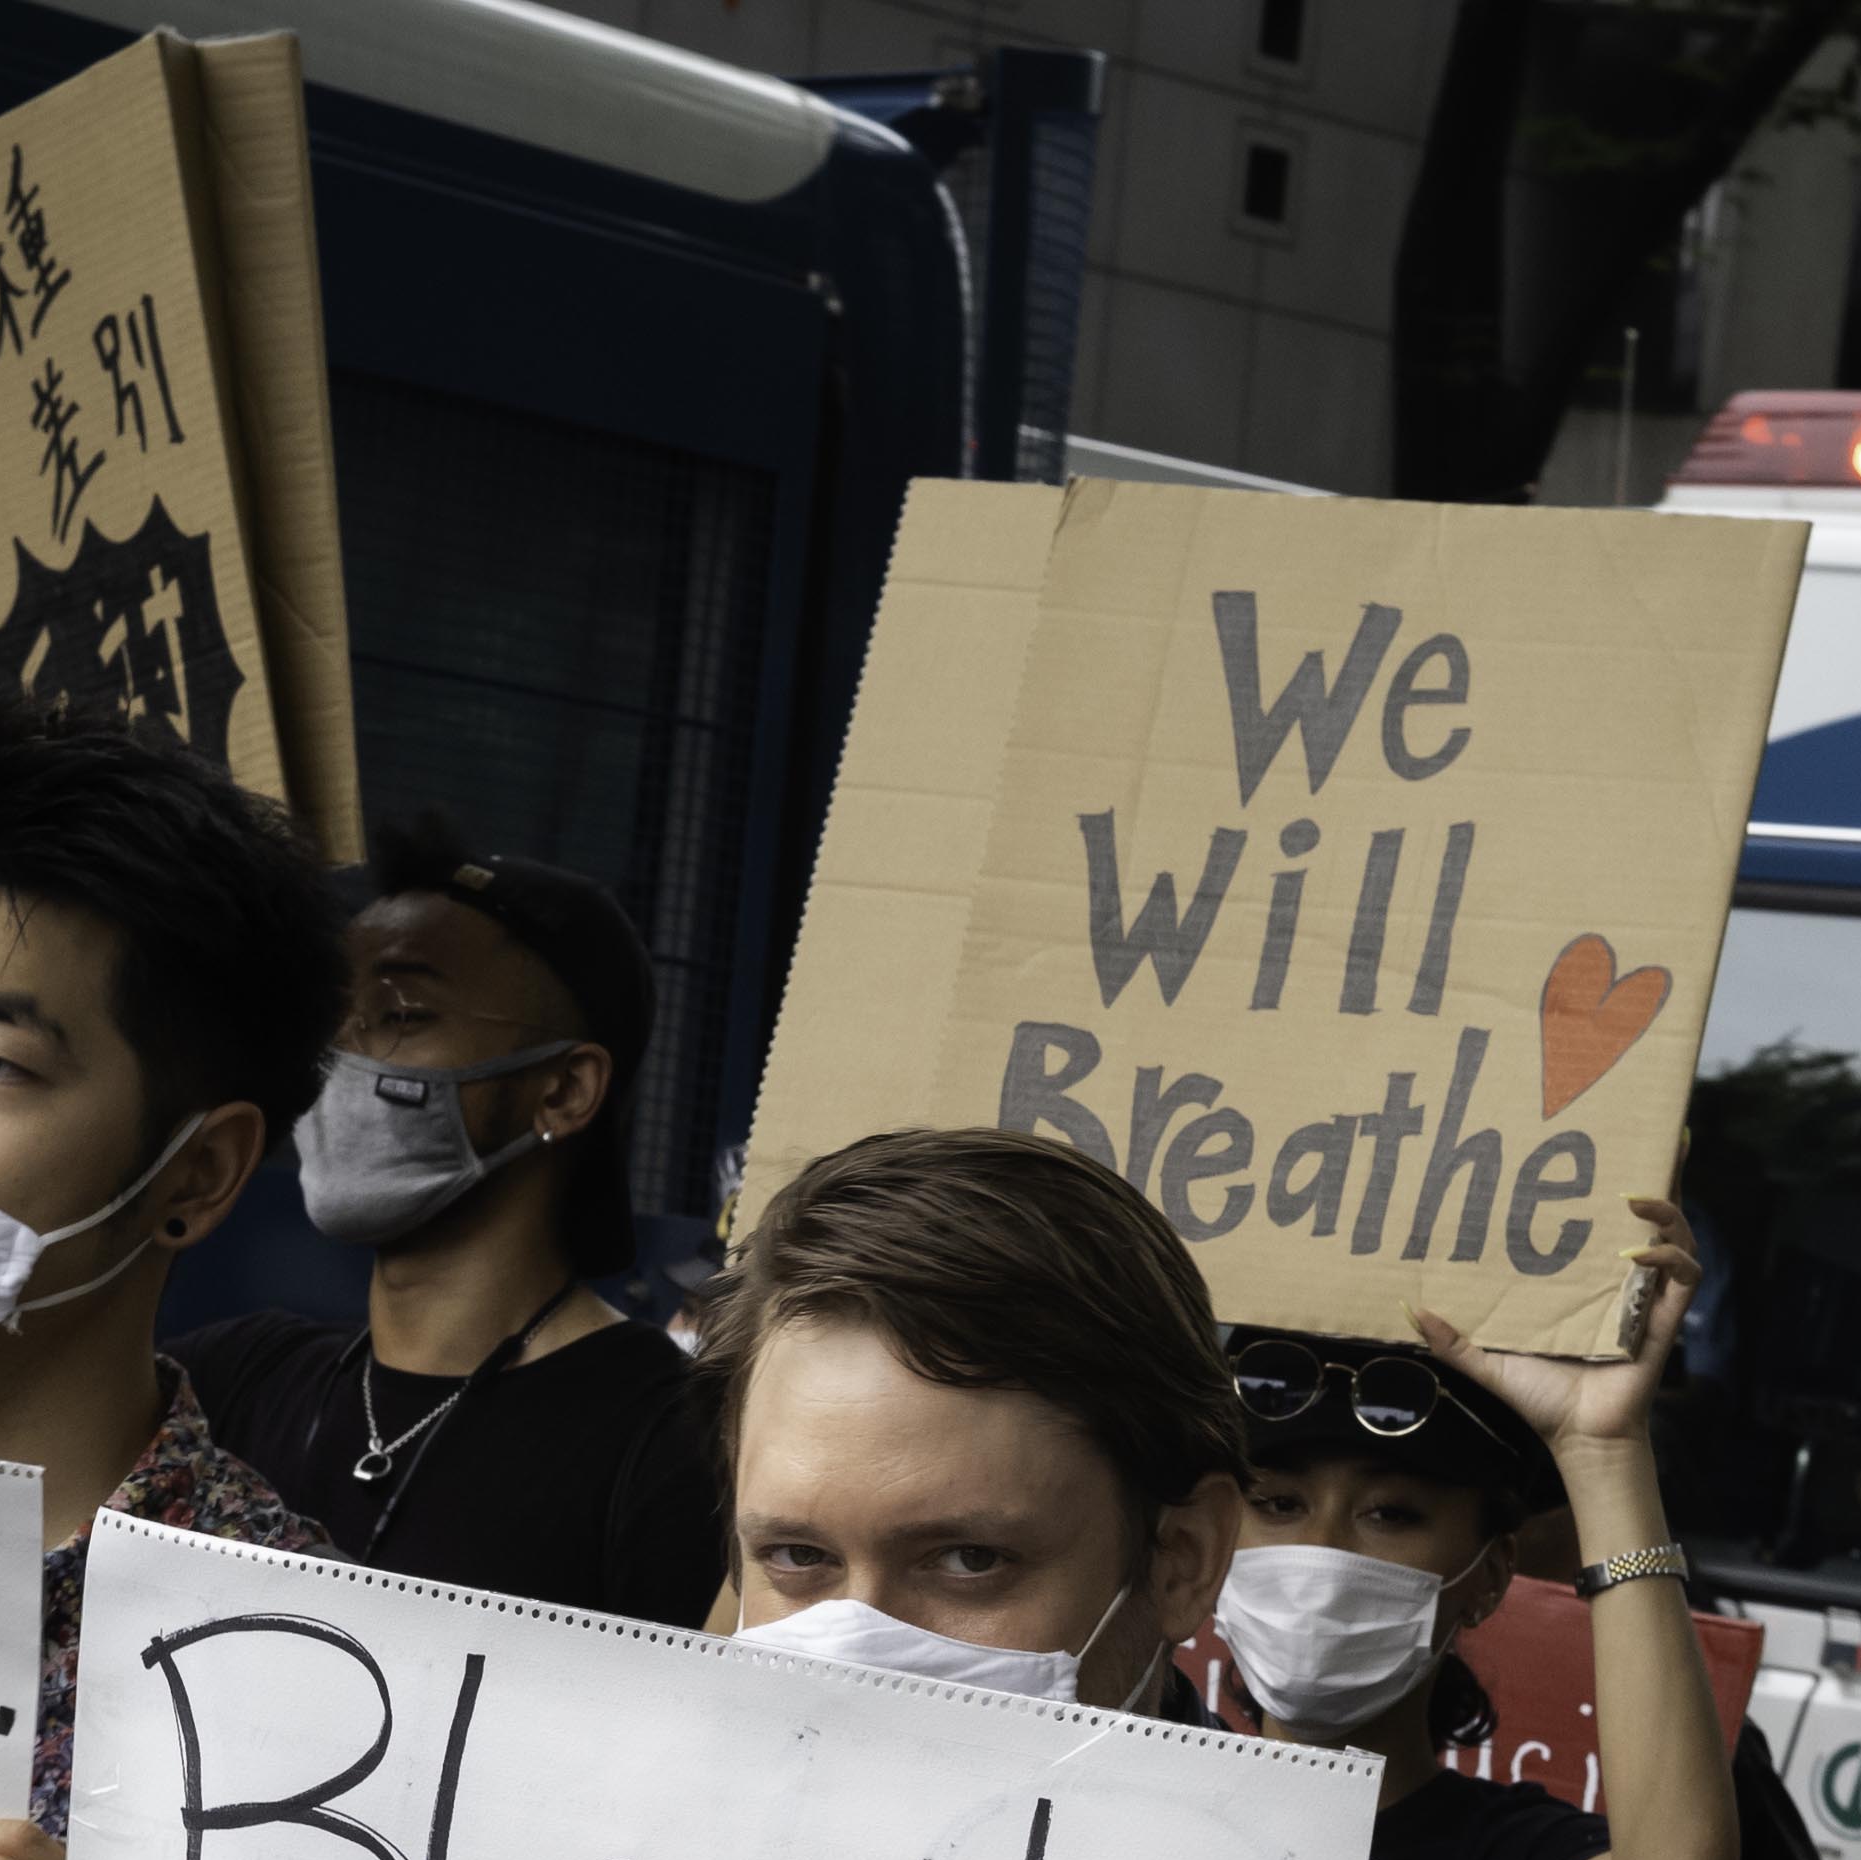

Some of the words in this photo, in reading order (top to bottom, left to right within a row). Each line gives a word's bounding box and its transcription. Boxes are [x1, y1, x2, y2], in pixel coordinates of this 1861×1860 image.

[29, 293, 186, 546] 差別
[1212, 590, 1473, 807] We
[1077, 807, 1475, 1016] Will
[996, 1020, 1596, 1276] Breathe
